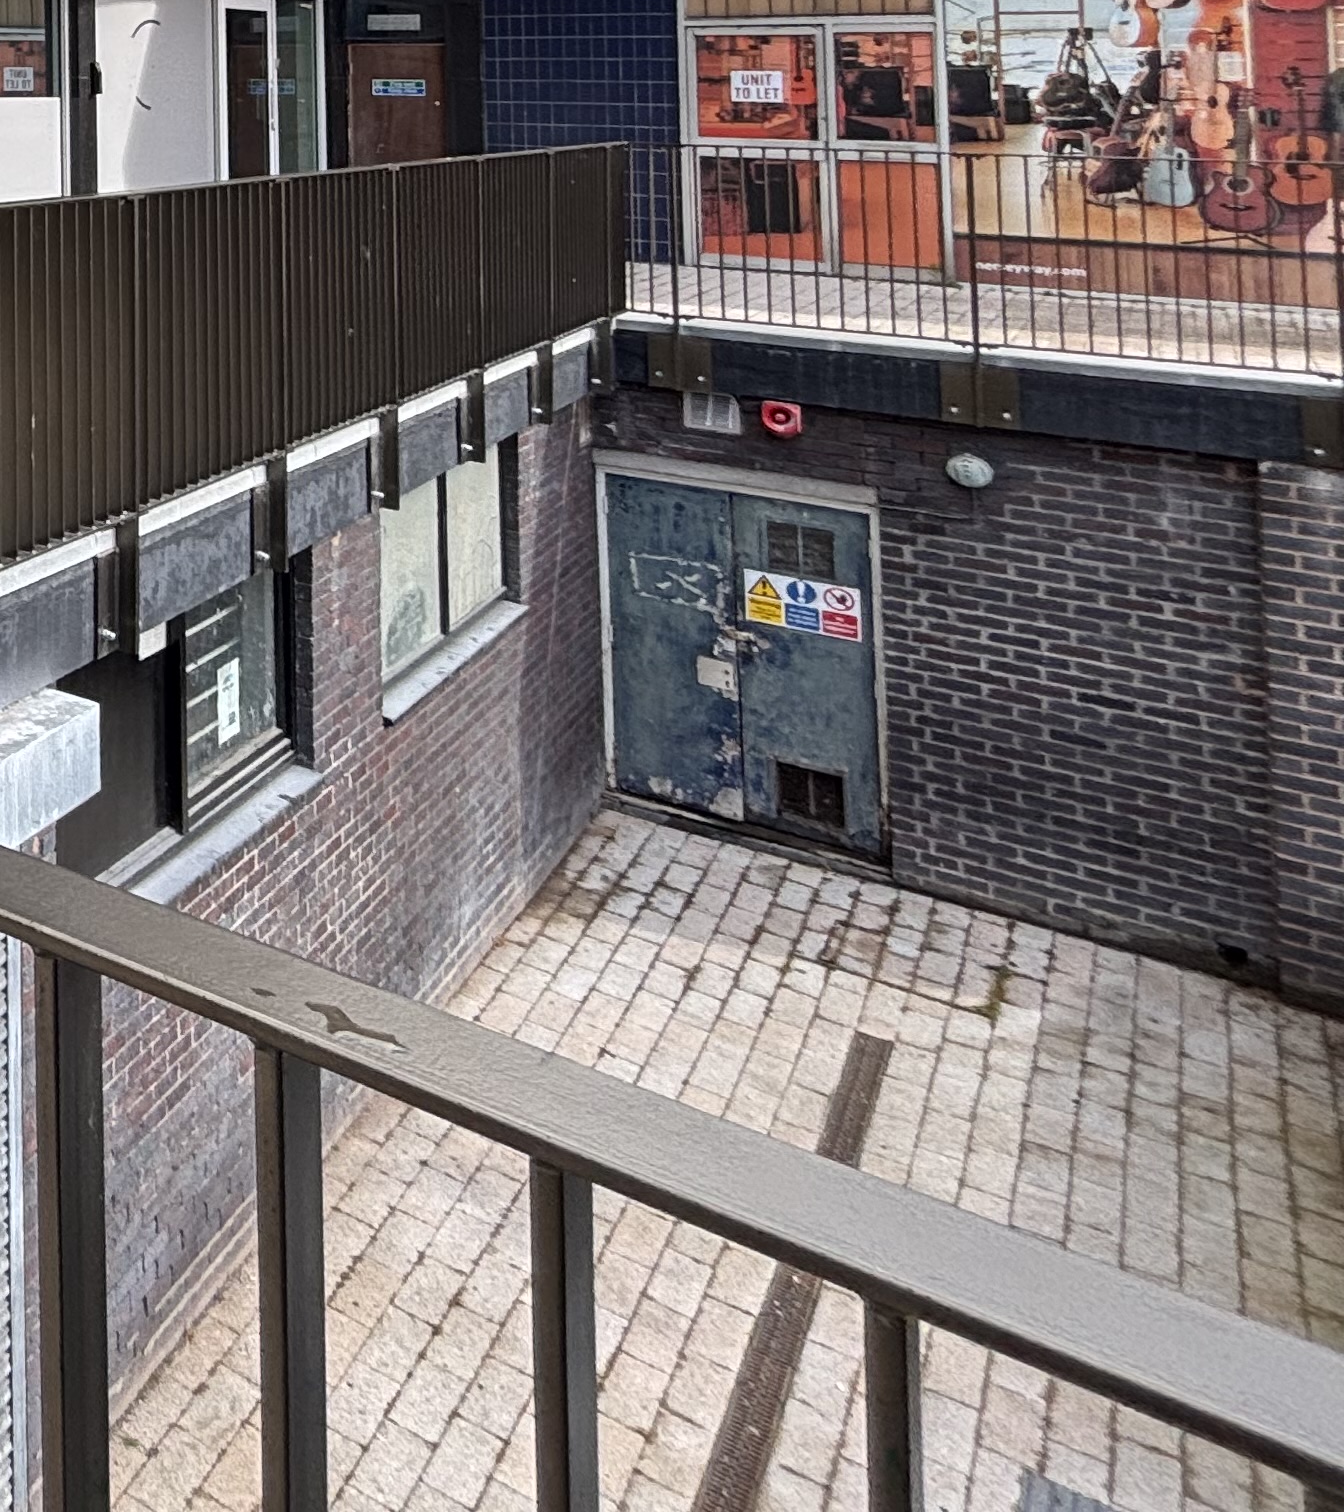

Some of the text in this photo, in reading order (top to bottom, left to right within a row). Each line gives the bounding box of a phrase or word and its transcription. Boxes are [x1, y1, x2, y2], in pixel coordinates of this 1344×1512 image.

[741, 74, 773, 86] UNIT
[735, 87, 780, 100] TO LET
